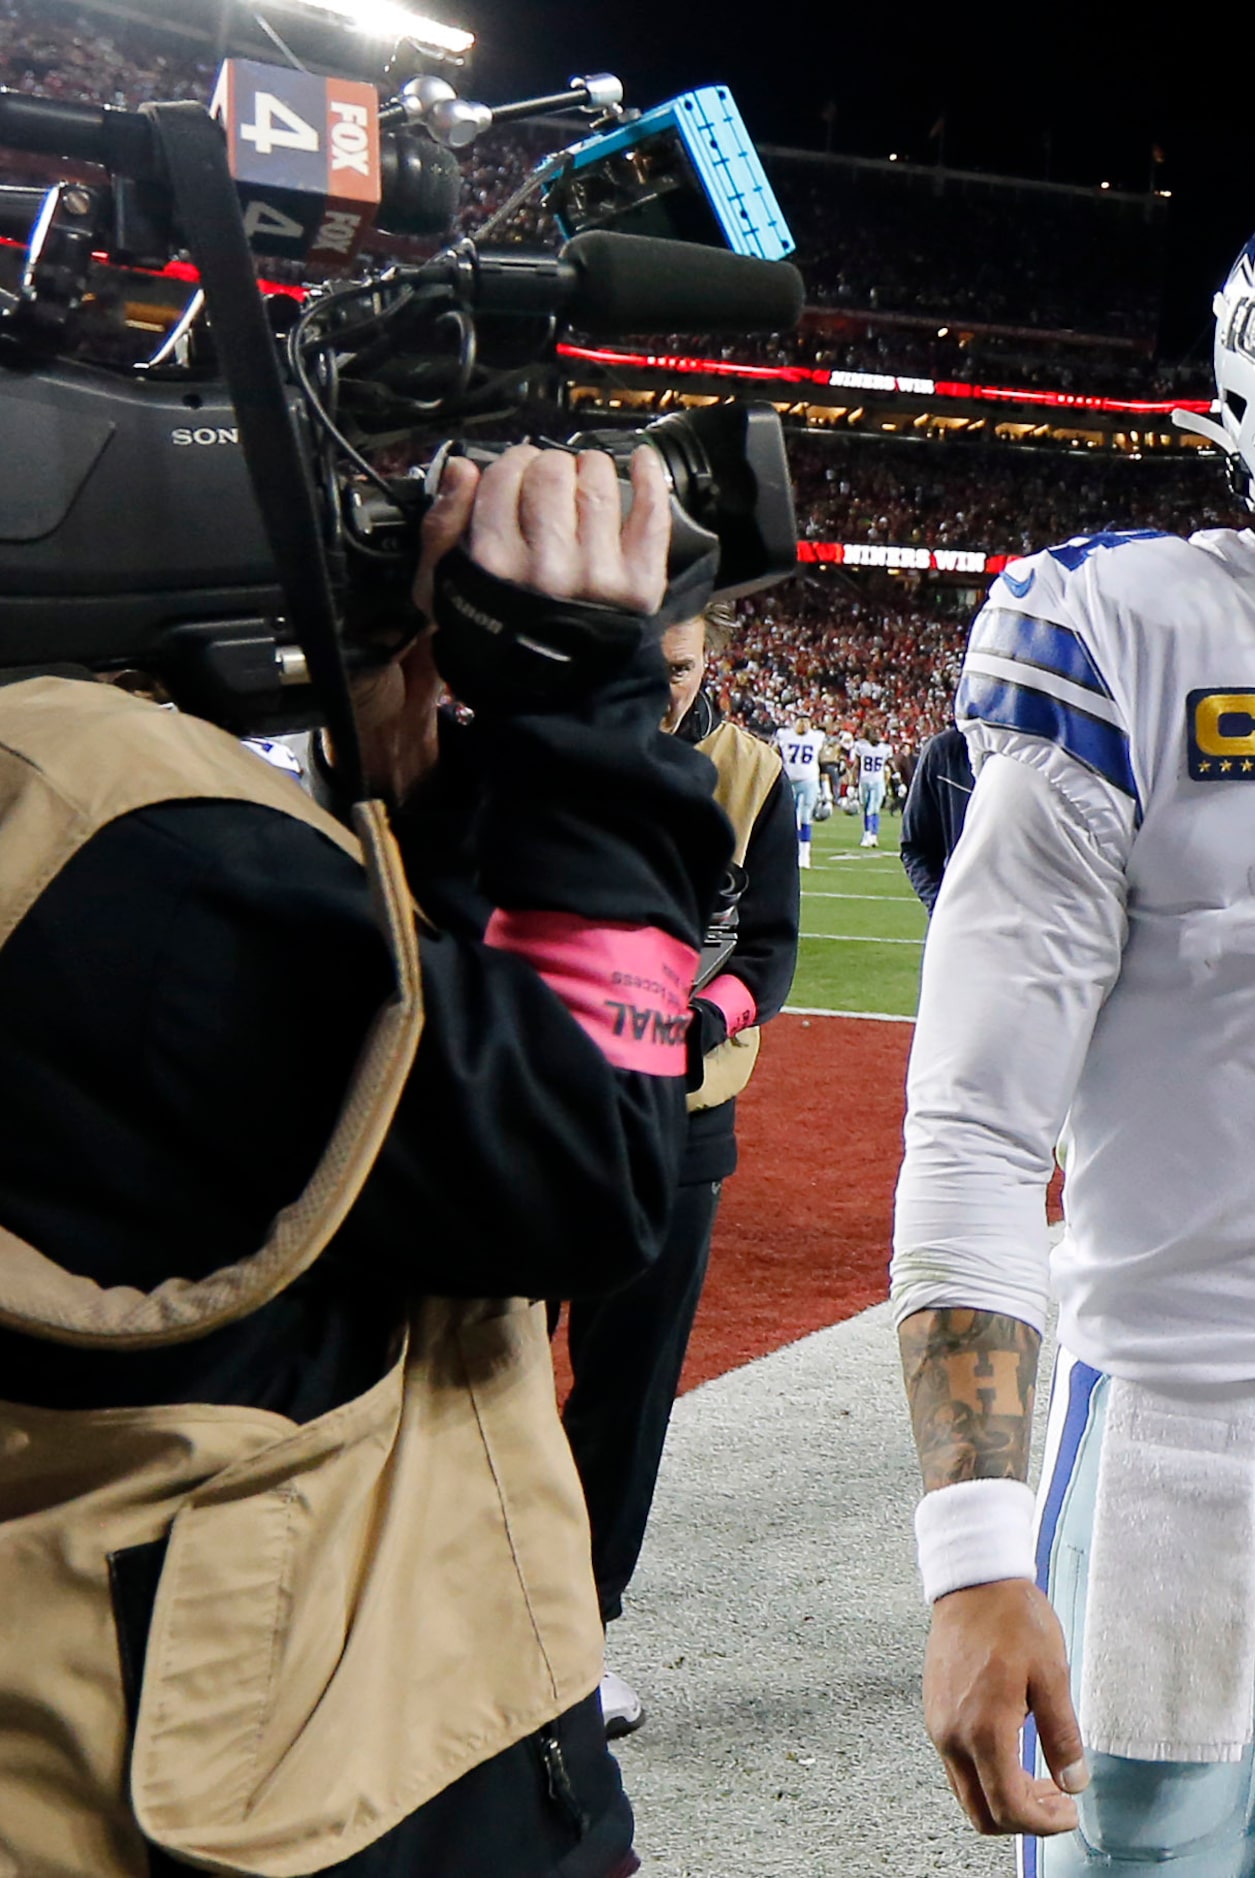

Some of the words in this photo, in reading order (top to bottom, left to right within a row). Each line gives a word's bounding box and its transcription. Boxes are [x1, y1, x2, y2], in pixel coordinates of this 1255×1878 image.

[240, 91, 320, 154] 4
[330, 101, 370, 176] FOX
[312, 210, 362, 255] FOX
[171, 427, 239, 446] SON
[843, 543, 931, 569] NINERS
[933, 549, 987, 573] WIN
[788, 743, 814, 764] 76
